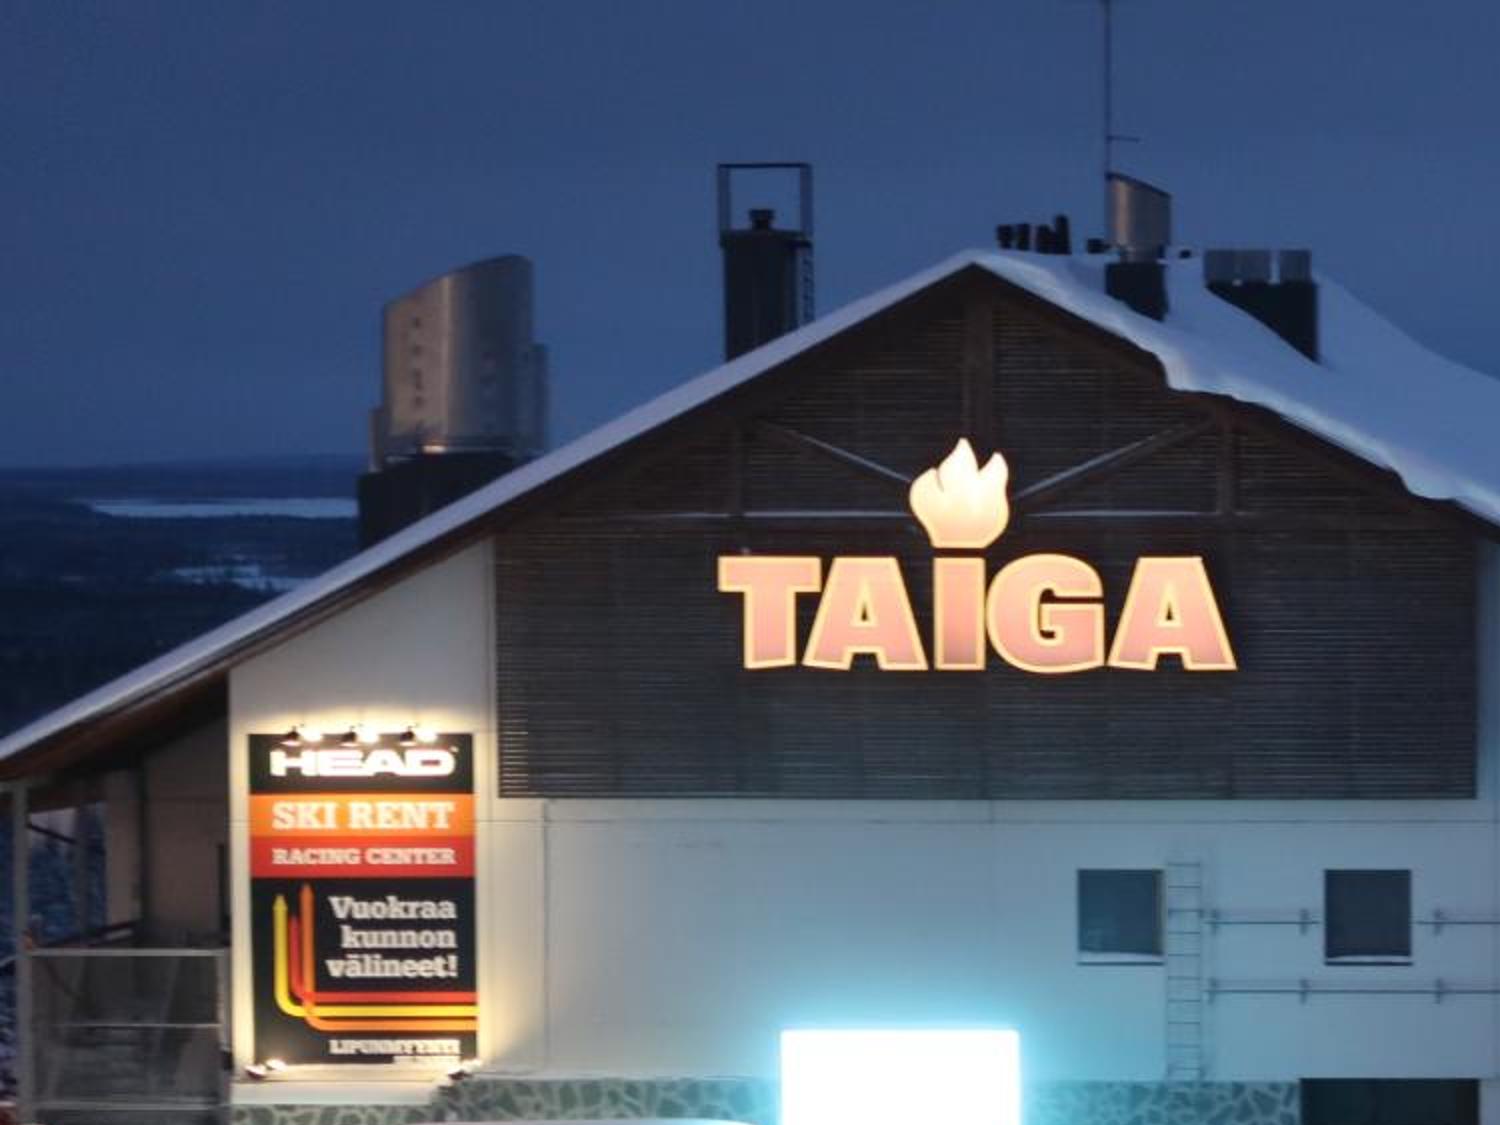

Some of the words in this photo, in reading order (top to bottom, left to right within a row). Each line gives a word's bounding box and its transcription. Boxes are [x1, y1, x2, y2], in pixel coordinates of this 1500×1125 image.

[717, 553, 1237, 674] TAIGA
[270, 749, 455, 776] HEAD
[272, 801, 337, 829] SKI
[349, 801, 455, 829] RENT
[272, 848, 360, 865] RACING
[365, 848, 455, 865] CENTER
[328, 896, 456, 919] Vuokraa
[341, 925, 456, 948] kunnon
[326, 955, 457, 977] välineet!
